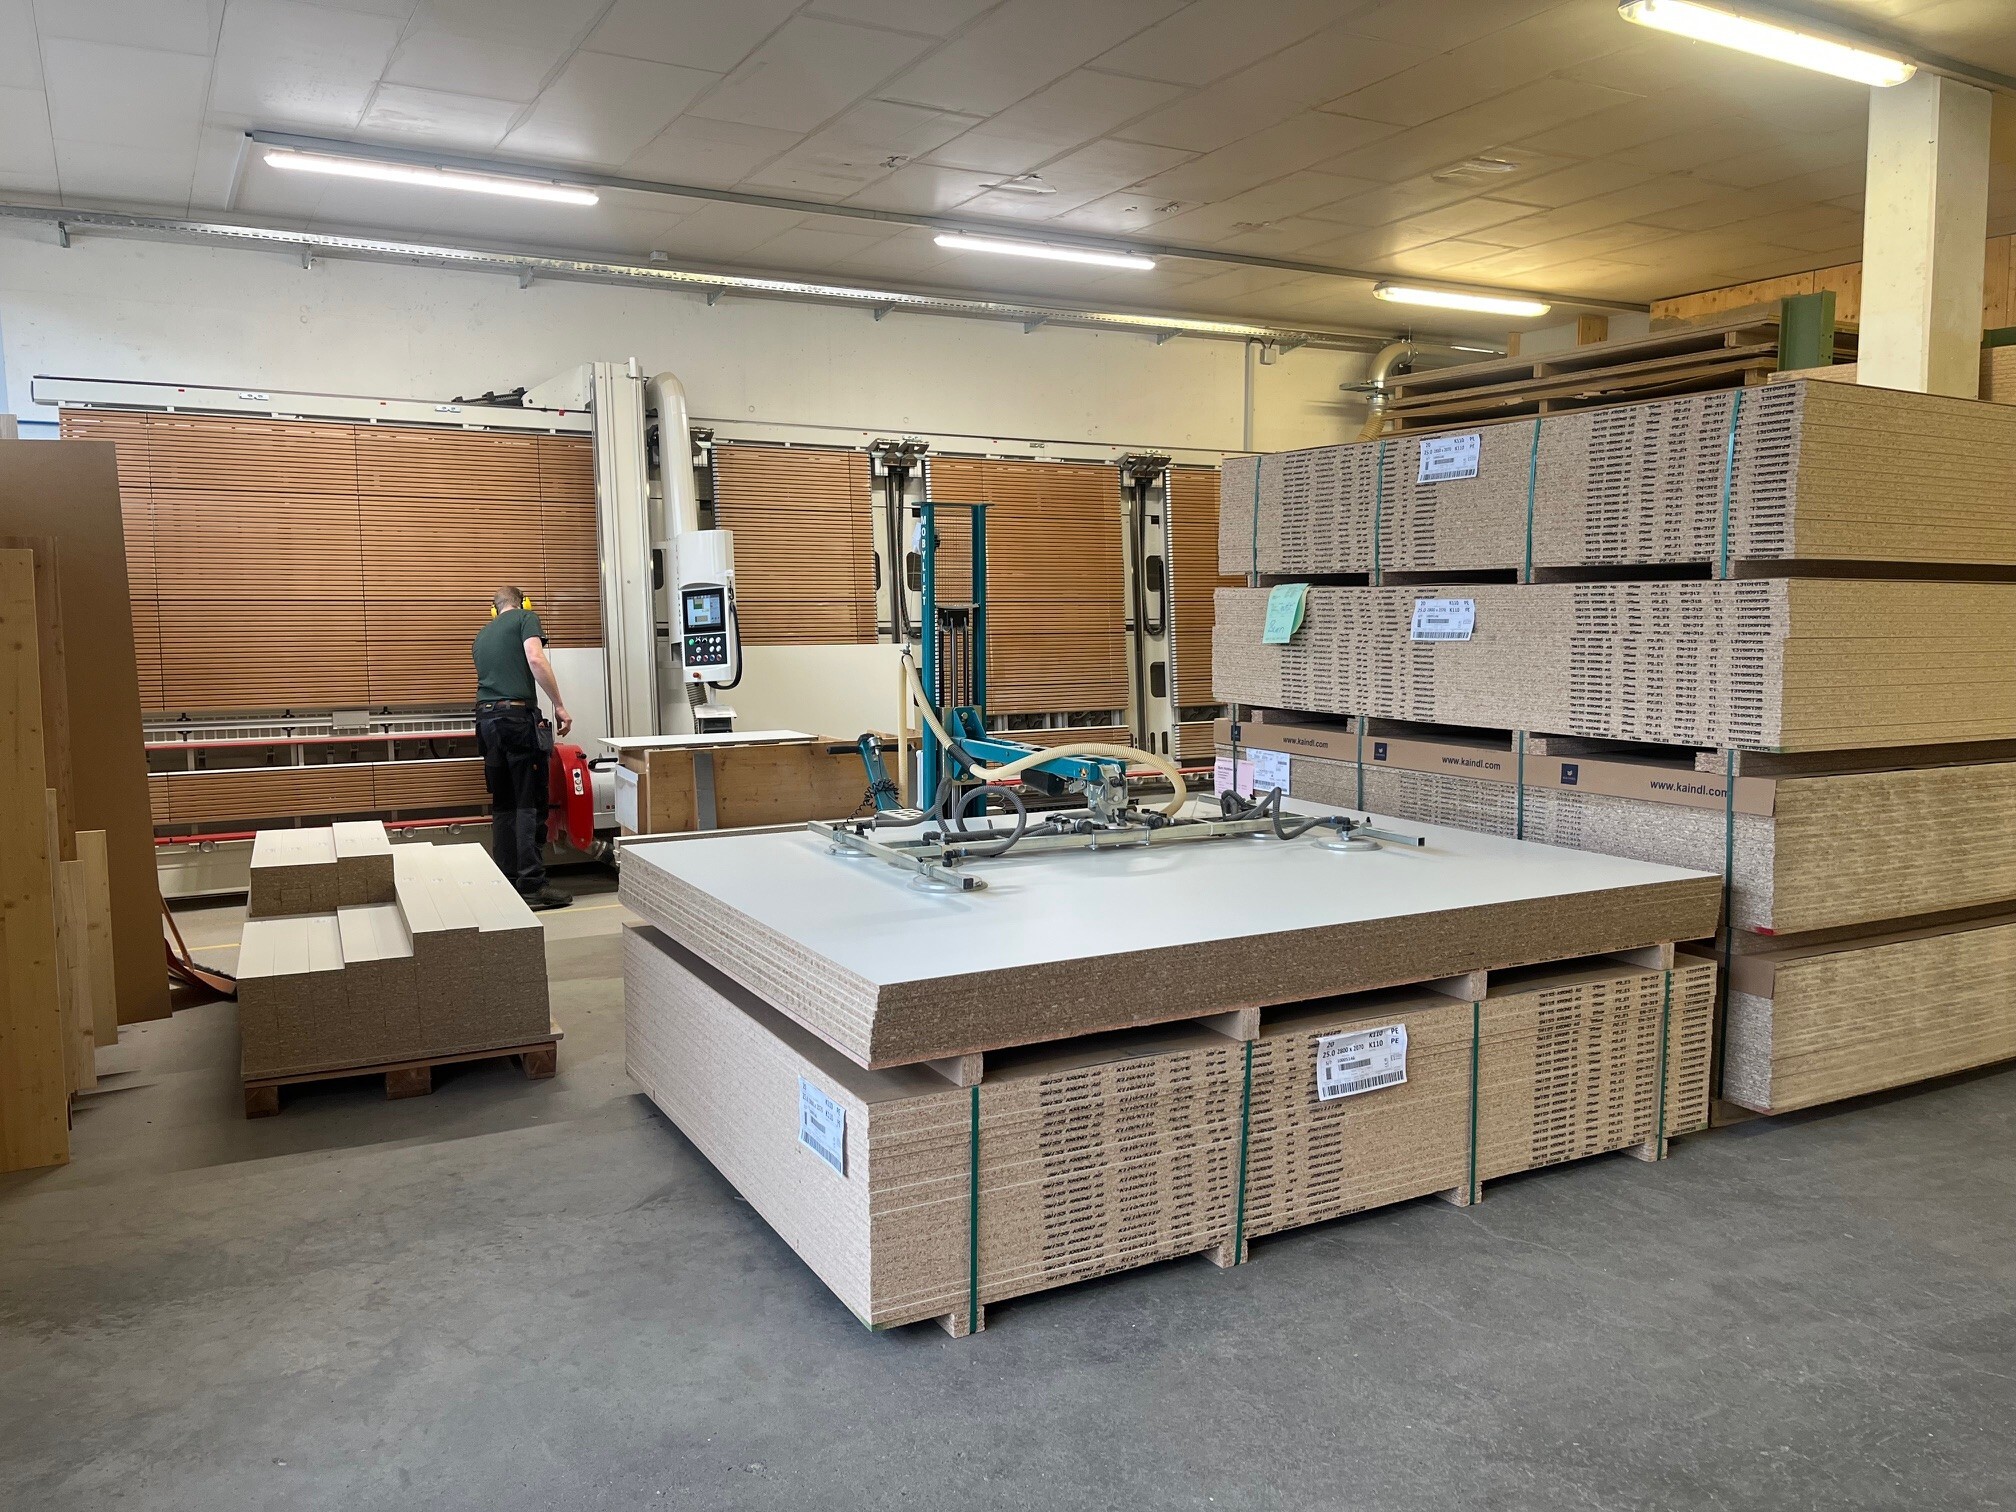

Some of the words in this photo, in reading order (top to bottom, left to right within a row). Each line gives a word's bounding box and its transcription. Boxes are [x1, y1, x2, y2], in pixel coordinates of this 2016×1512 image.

[1282, 738, 1328, 748] www.kaindl.com
[1442, 757, 1500, 770] www.kaindl.com
[1369, 1030, 1383, 1038] K110
[1323, 1050, 1335, 1058] 25.0
[1369, 1040, 1383, 1048] K110
